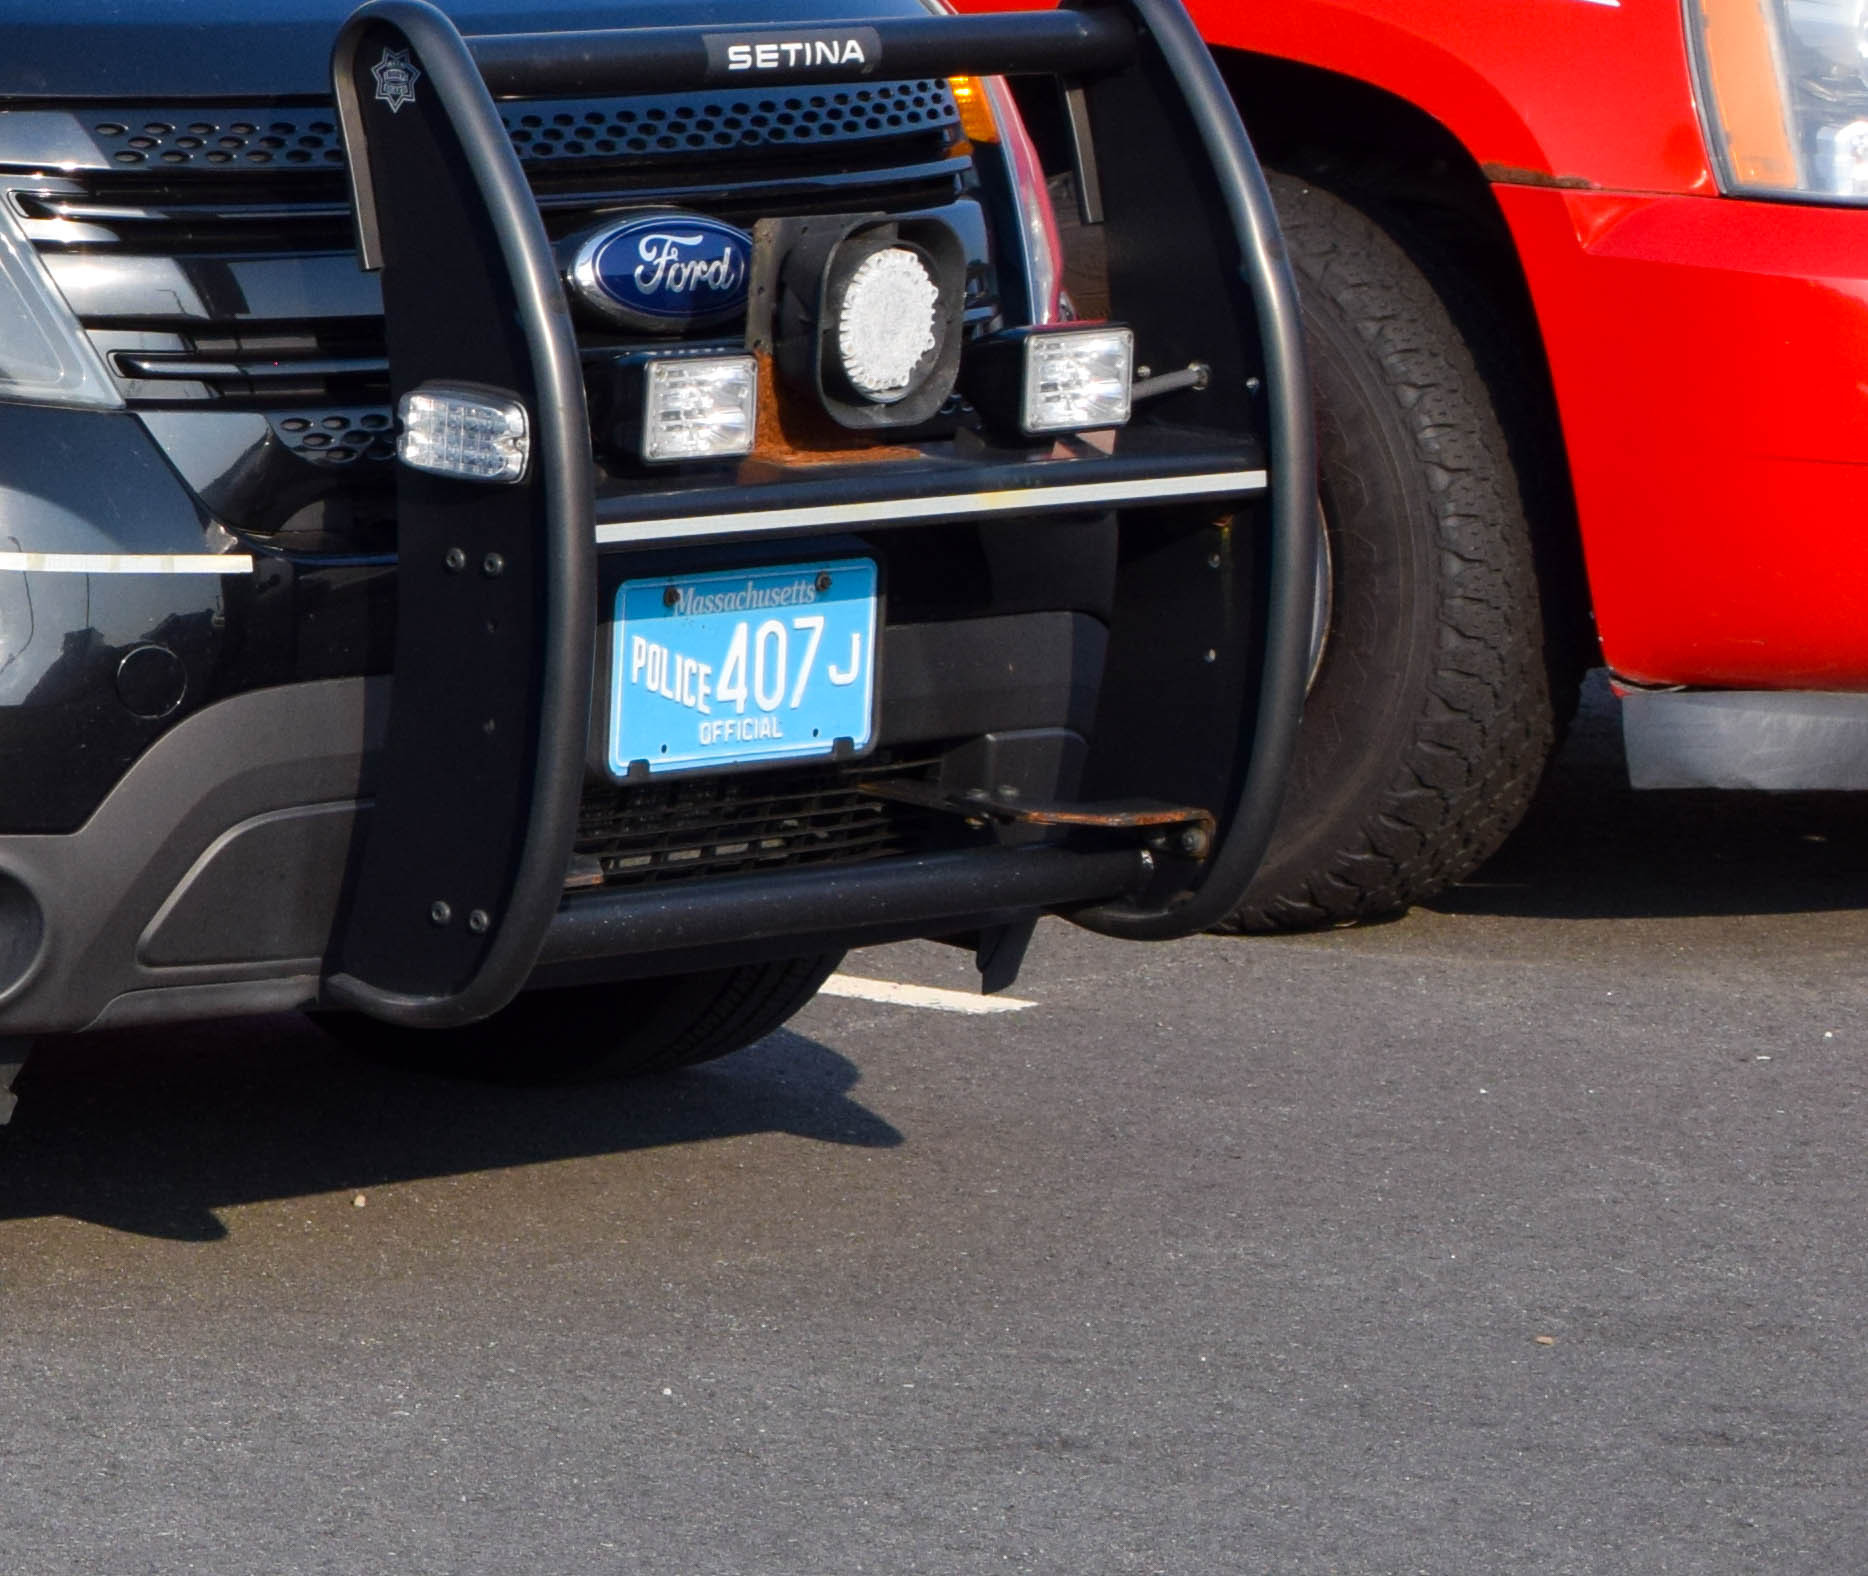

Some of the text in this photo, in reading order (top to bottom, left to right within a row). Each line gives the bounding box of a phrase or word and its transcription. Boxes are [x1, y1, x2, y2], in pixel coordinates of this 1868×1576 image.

[727, 39, 865, 70] SETINA
[635, 233, 734, 297] Ford
[673, 581, 815, 617] Massachusetts
[631, 635, 712, 715] POLICE
[699, 716, 783, 745] OFFICIAL
